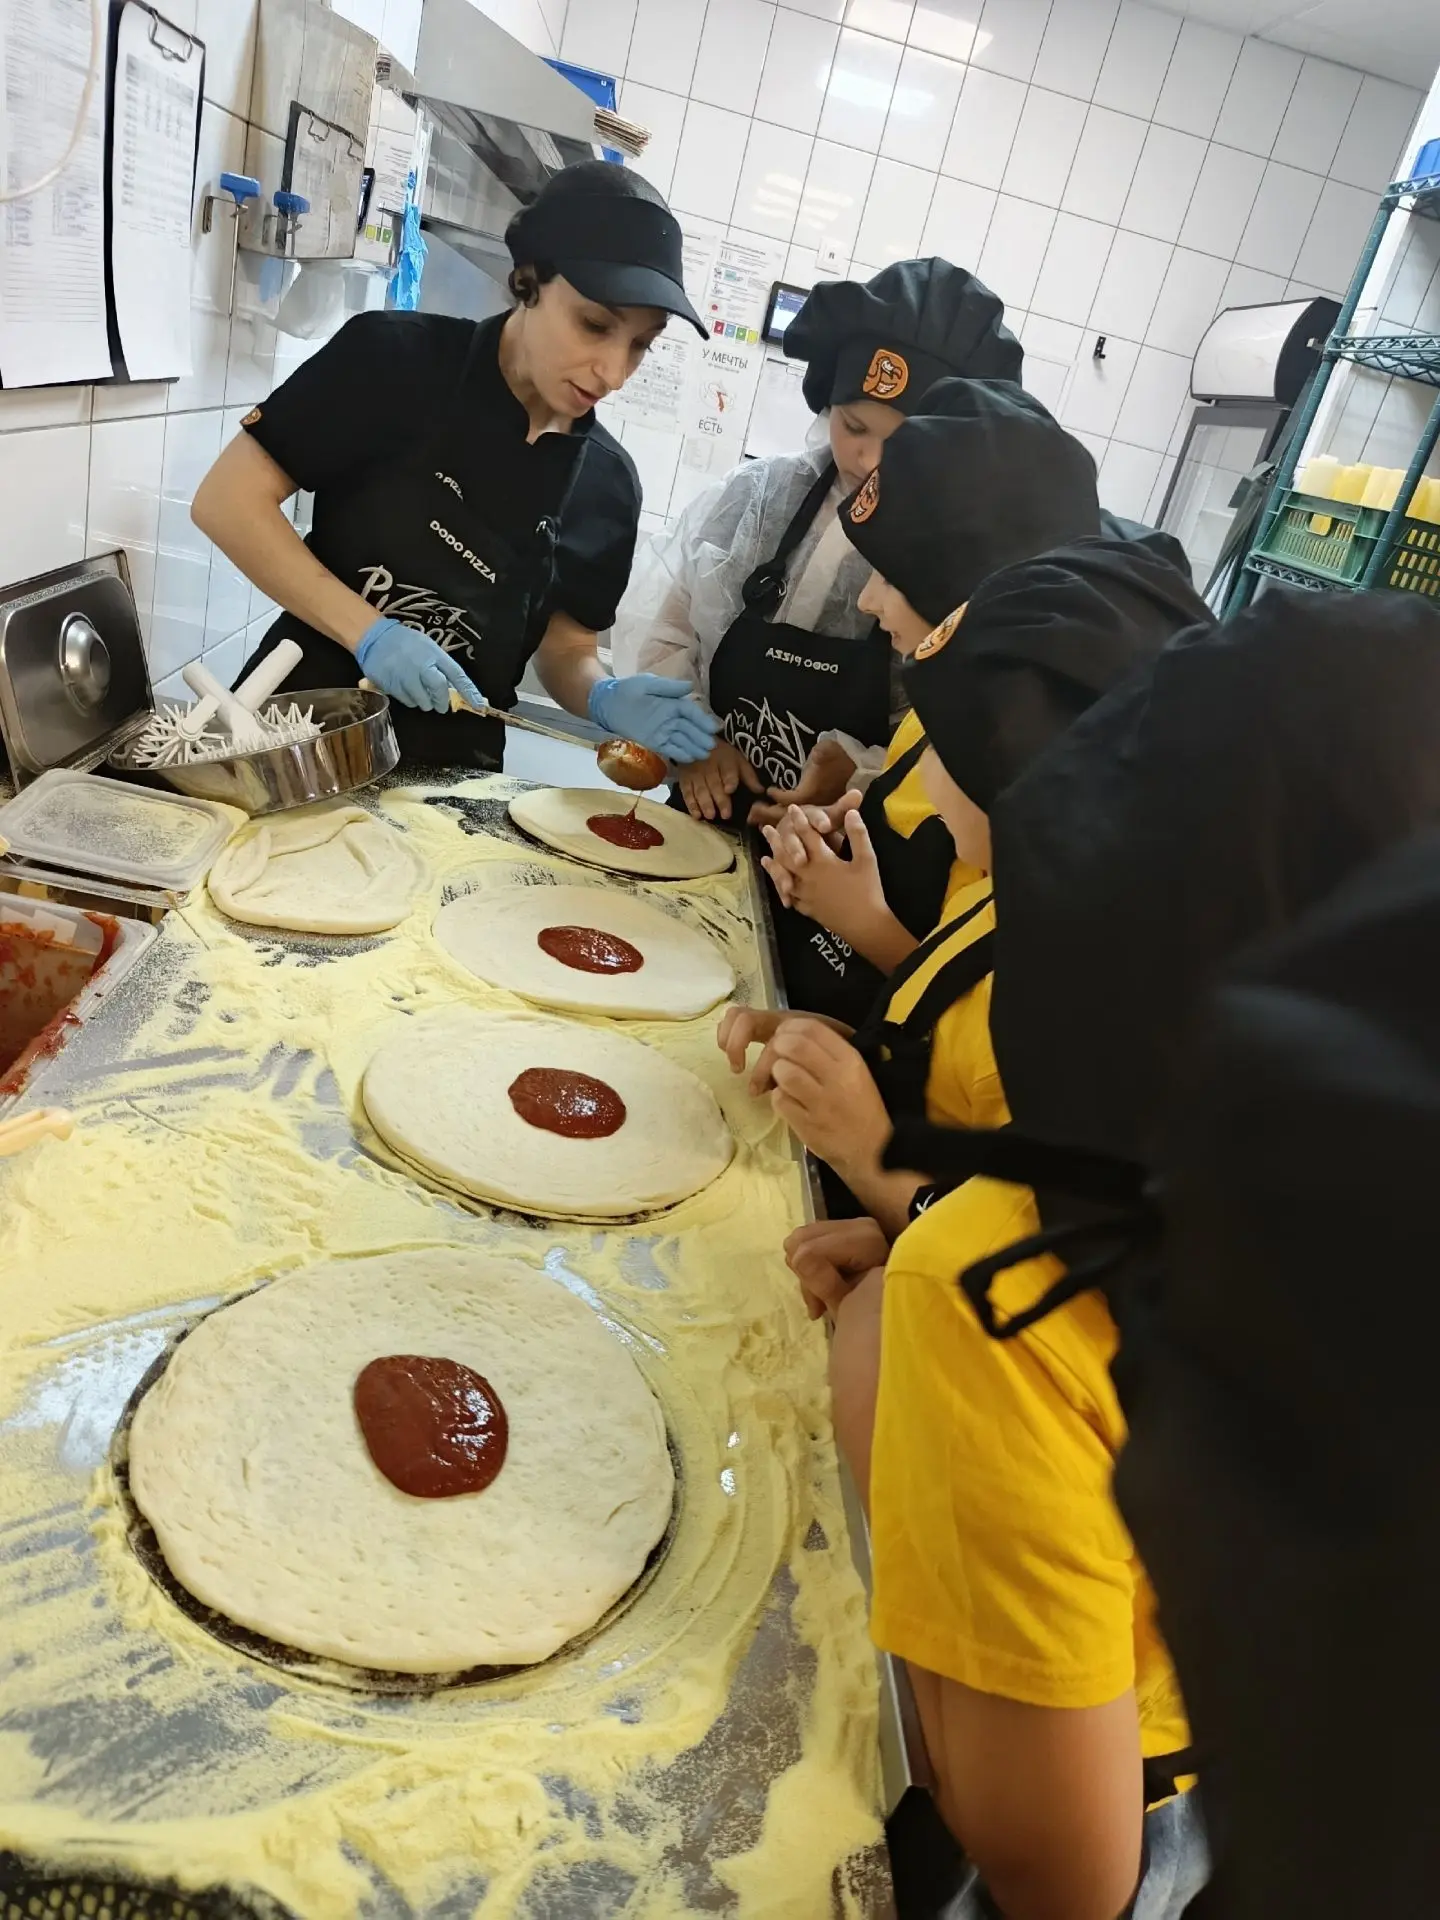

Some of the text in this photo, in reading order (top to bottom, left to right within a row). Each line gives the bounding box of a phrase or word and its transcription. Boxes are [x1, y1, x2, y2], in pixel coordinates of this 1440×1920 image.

[703, 347, 710, 359] У
[712, 351, 748, 369] МЕЧТЫ
[698, 420, 723, 434] ЕСТЬ
[430, 520, 496, 583] DODO PIZZA
[810, 933, 846, 977] PIZZA
